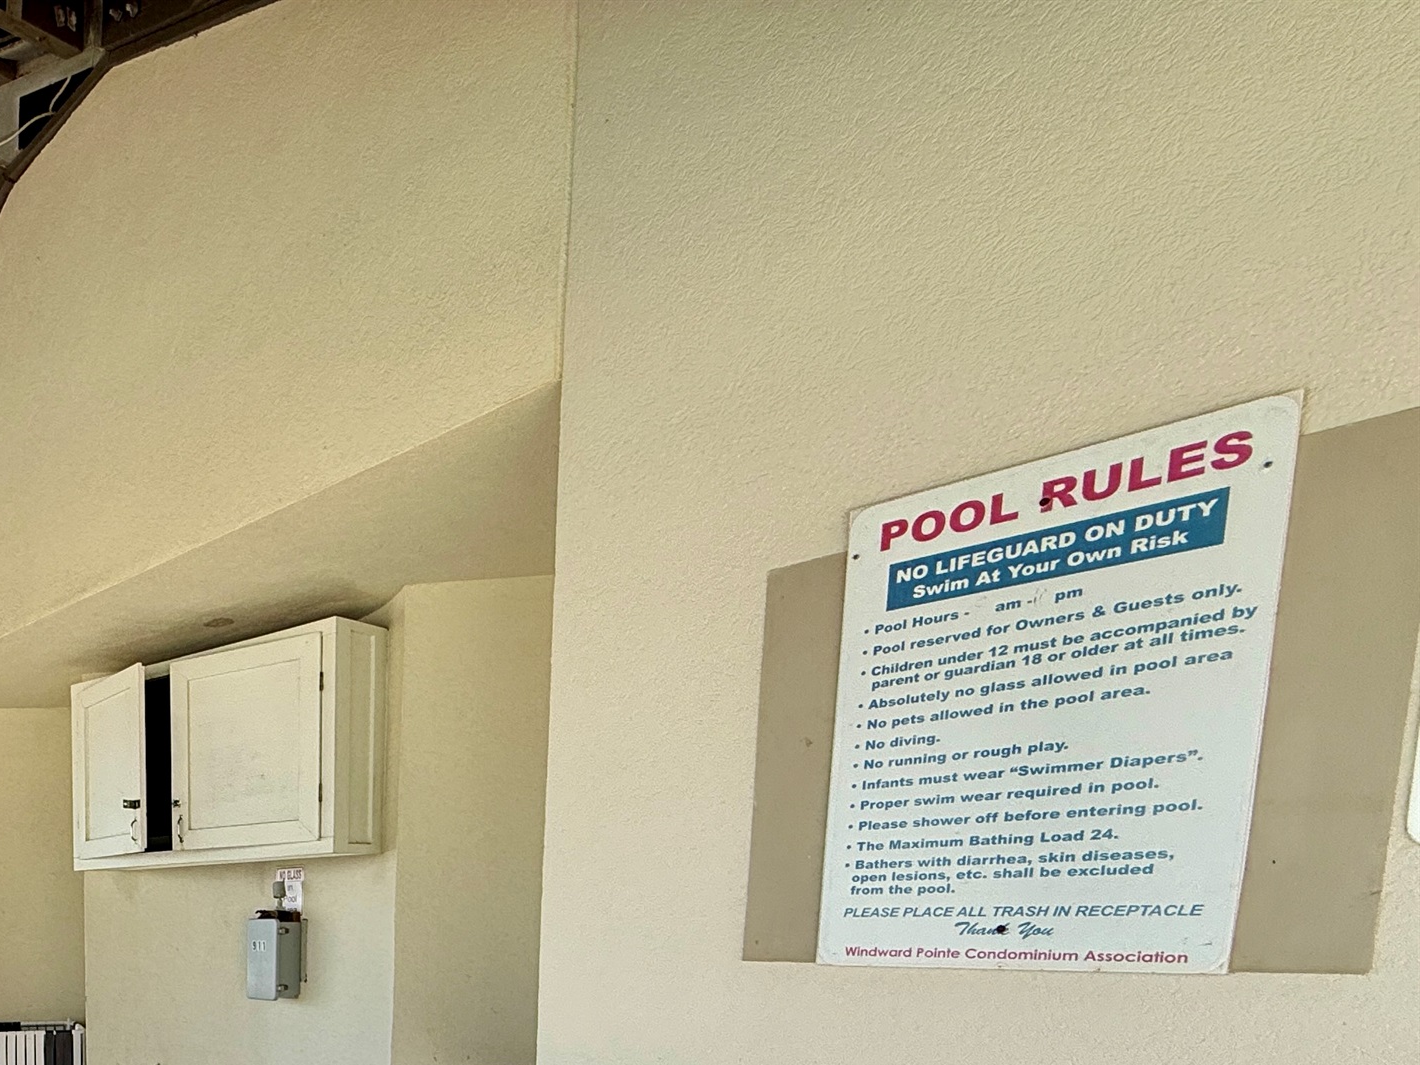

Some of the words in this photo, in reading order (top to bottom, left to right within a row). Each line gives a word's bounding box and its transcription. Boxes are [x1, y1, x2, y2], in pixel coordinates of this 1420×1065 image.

[880, 492, 1019, 552] POOL
[1038, 431, 1253, 513] RULES
[896, 565, 928, 583] NO
[936, 532, 1076, 575] LIFEGUARD
[1085, 520, 1125, 541] ON
[1135, 498, 1218, 532] DUTY
[913, 578, 969, 598] Swim
[975, 569, 1000, 586] At
[1008, 559, 1060, 578] Your
[1067, 547, 1121, 566] Own
[1131, 530, 1188, 554] Risk
[873, 640, 905, 656] Pool
[910, 627, 981, 650] reserved
[986, 624, 1011, 636] for
[1015, 611, 1085, 631] Owners
[1092, 605, 1106, 618] &
[1113, 593, 1185, 614] Guests
[1191, 584, 1242, 600] only.
[875, 619, 907, 635] Pool
[912, 612, 959, 628] Hours
[995, 600, 1022, 612] am
[1054, 588, 1083, 604] pm
[871, 659, 933, 676] Children
[938, 651, 984, 666] under
[988, 645, 1009, 657] 12
[1013, 637, 1057, 654] must
[1062, 635, 1085, 646] be
[1090, 608, 1225, 642] accompanied
[1231, 606, 1258, 620] by
[871, 673, 920, 692] parent
[924, 671, 941, 681] or
[944, 660, 1016, 681] guardian
[1021, 653, 1042, 666] 18
[1047, 652, 1067, 662] or
[1071, 643, 1119, 659] older
[1124, 637, 1144, 651] at
[1149, 632, 1174, 647] all
[1180, 625, 1246, 642] times.
[868, 690, 950, 710] Absolutely
[955, 688, 975, 698] no
[980, 680, 1026, 697] glass
[1031, 666, 1103, 687] allowed
[1110, 664, 1127, 676] in
[1133, 655, 1178, 676] pool
[1184, 651, 1233, 666] area
[867, 719, 887, 730] No
[891, 715, 925, 729] pets
[930, 704, 994, 722] allowed
[999, 702, 1014, 713] in
[1020, 698, 1049, 710] the
[1054, 690, 1095, 709] pool
[1100, 687, 1151, 701] area.
[864, 759, 884, 770] No
[888, 753, 947, 767] running
[951, 751, 969, 761] or
[973, 744, 1022, 759] rough
[1027, 741, 1069, 756] play.
[865, 740, 885, 751] No
[890, 735, 941, 748] diving.
[862, 777, 914, 790] Infants
[918, 772, 958, 785] must
[963, 770, 1005, 781] wear
[1110, 749, 1203, 769] Diapers”.
[860, 799, 910, 811] Proper
[914, 794, 955, 806] swim
[960, 792, 1003, 802] wear
[1006, 783, 1082, 800] required
[1088, 782, 1105, 793] in
[1111, 777, 1159, 794] pool.
[858, 820, 908, 831] Please
[913, 816, 971, 828] shower
[975, 812, 999, 824] off
[1004, 809, 1061, 822] before
[1066, 804, 1146, 818] entering
[1153, 799, 1203, 816] pool.
[857, 841, 884, 851] The
[889, 838, 964, 850] Maximum
[969, 833, 1034, 846] Bathing
[1040, 830, 1085, 843] Load
[1089, 828, 1119, 840] 24.
[287, 869, 302, 880] GLASS
[851, 874, 887, 885] open
[891, 871, 951, 882] lesions,
[956, 869, 987, 880] etc.
[993, 867, 1034, 879] shall
[1040, 867, 1061, 877] be
[1067, 863, 1154, 877] excluded
[855, 859, 912, 870] Bathers
[917, 856, 951, 867] with
[957, 854, 1032, 866] diarrhea,
[1038, 852, 1076, 863] skin
[1082, 850, 1174, 862] diseases,
[850, 885, 883, 895] from
[888, 884, 913, 895] the
[917, 883, 955, 896] pool.
[843, 907, 901, 918] PLEASE
[902, 906, 953, 917] PLACE
[956, 906, 987, 917] ALL
[993, 906, 1050, 917] TRASH
[1052, 905, 1072, 917] IN
[1075, 904, 1205, 917] RECEPTACLE
[252, 940, 266, 951] 911
[1017, 921, 1054, 940] You
[845, 946, 912, 958] Windward
[916, 947, 960, 959] Pointe
[965, 948, 1078, 961] Condominium
[1083, 950, 1188, 964] Association
